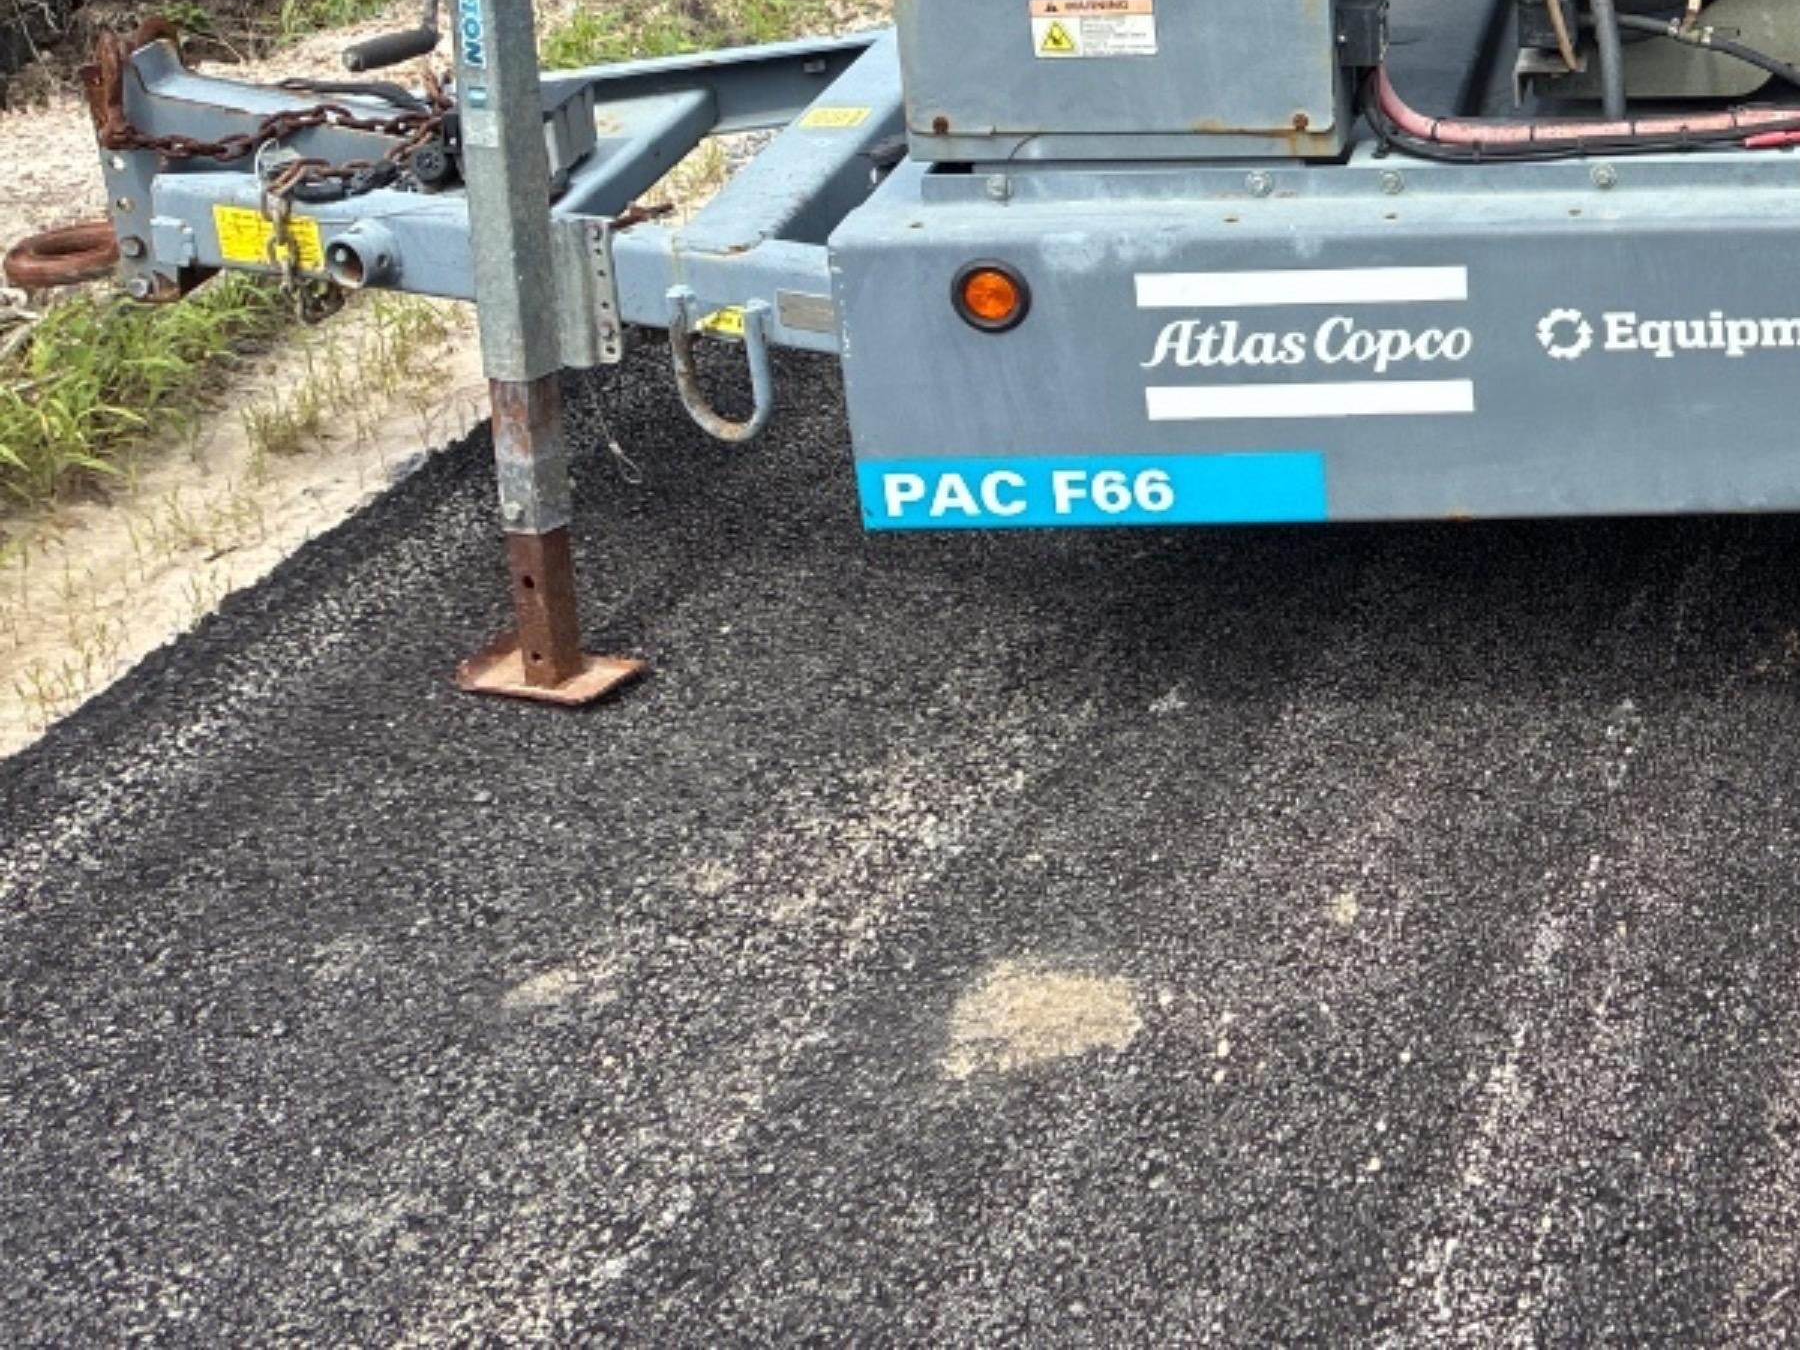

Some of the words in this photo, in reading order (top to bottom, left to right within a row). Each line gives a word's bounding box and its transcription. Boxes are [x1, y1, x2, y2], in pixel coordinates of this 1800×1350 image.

[1139, 318, 1308, 368] Atlas
[1313, 314, 1473, 374] Copco
[883, 471, 1027, 518] PAC
[1051, 469, 1176, 514] F66
